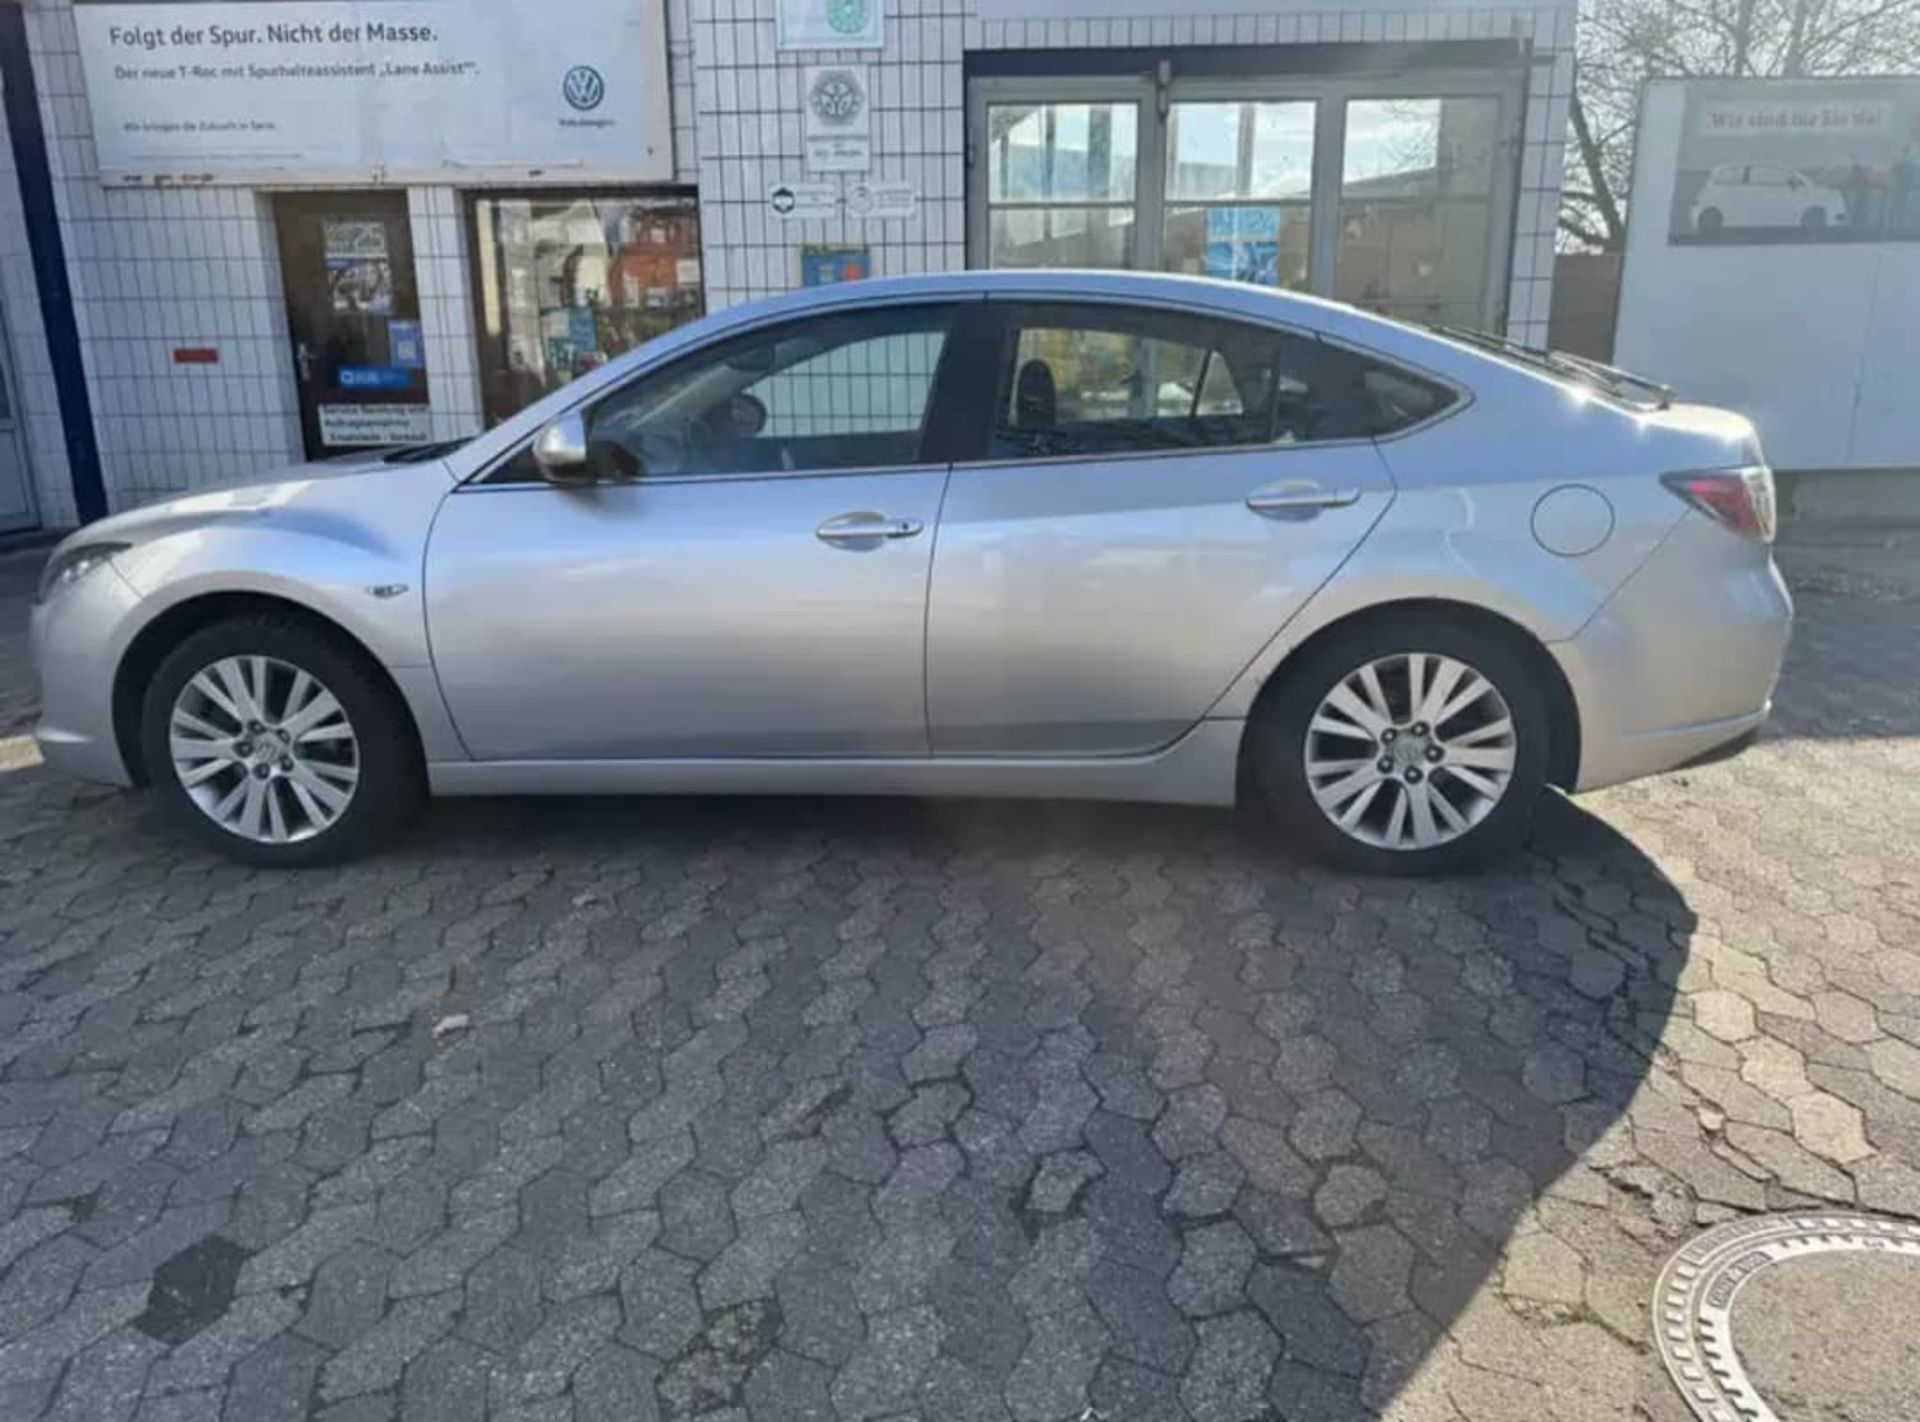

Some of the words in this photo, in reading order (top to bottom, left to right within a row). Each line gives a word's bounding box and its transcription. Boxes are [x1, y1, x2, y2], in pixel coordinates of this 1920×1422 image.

[109, 26, 166, 50] Folgt
[170, 25, 204, 45] der
[209, 25, 262, 48] Spur.
[267, 23, 323, 43] Nicht
[328, 23, 359, 43] der
[366, 22, 438, 42] Masse.
[114, 65, 138, 80] Der
[142, 67, 175, 79] neue
[178, 64, 218, 79] T-Roc
[221, 65, 246, 78] mit
[248, 63, 376, 79] Spurhalteassistent
